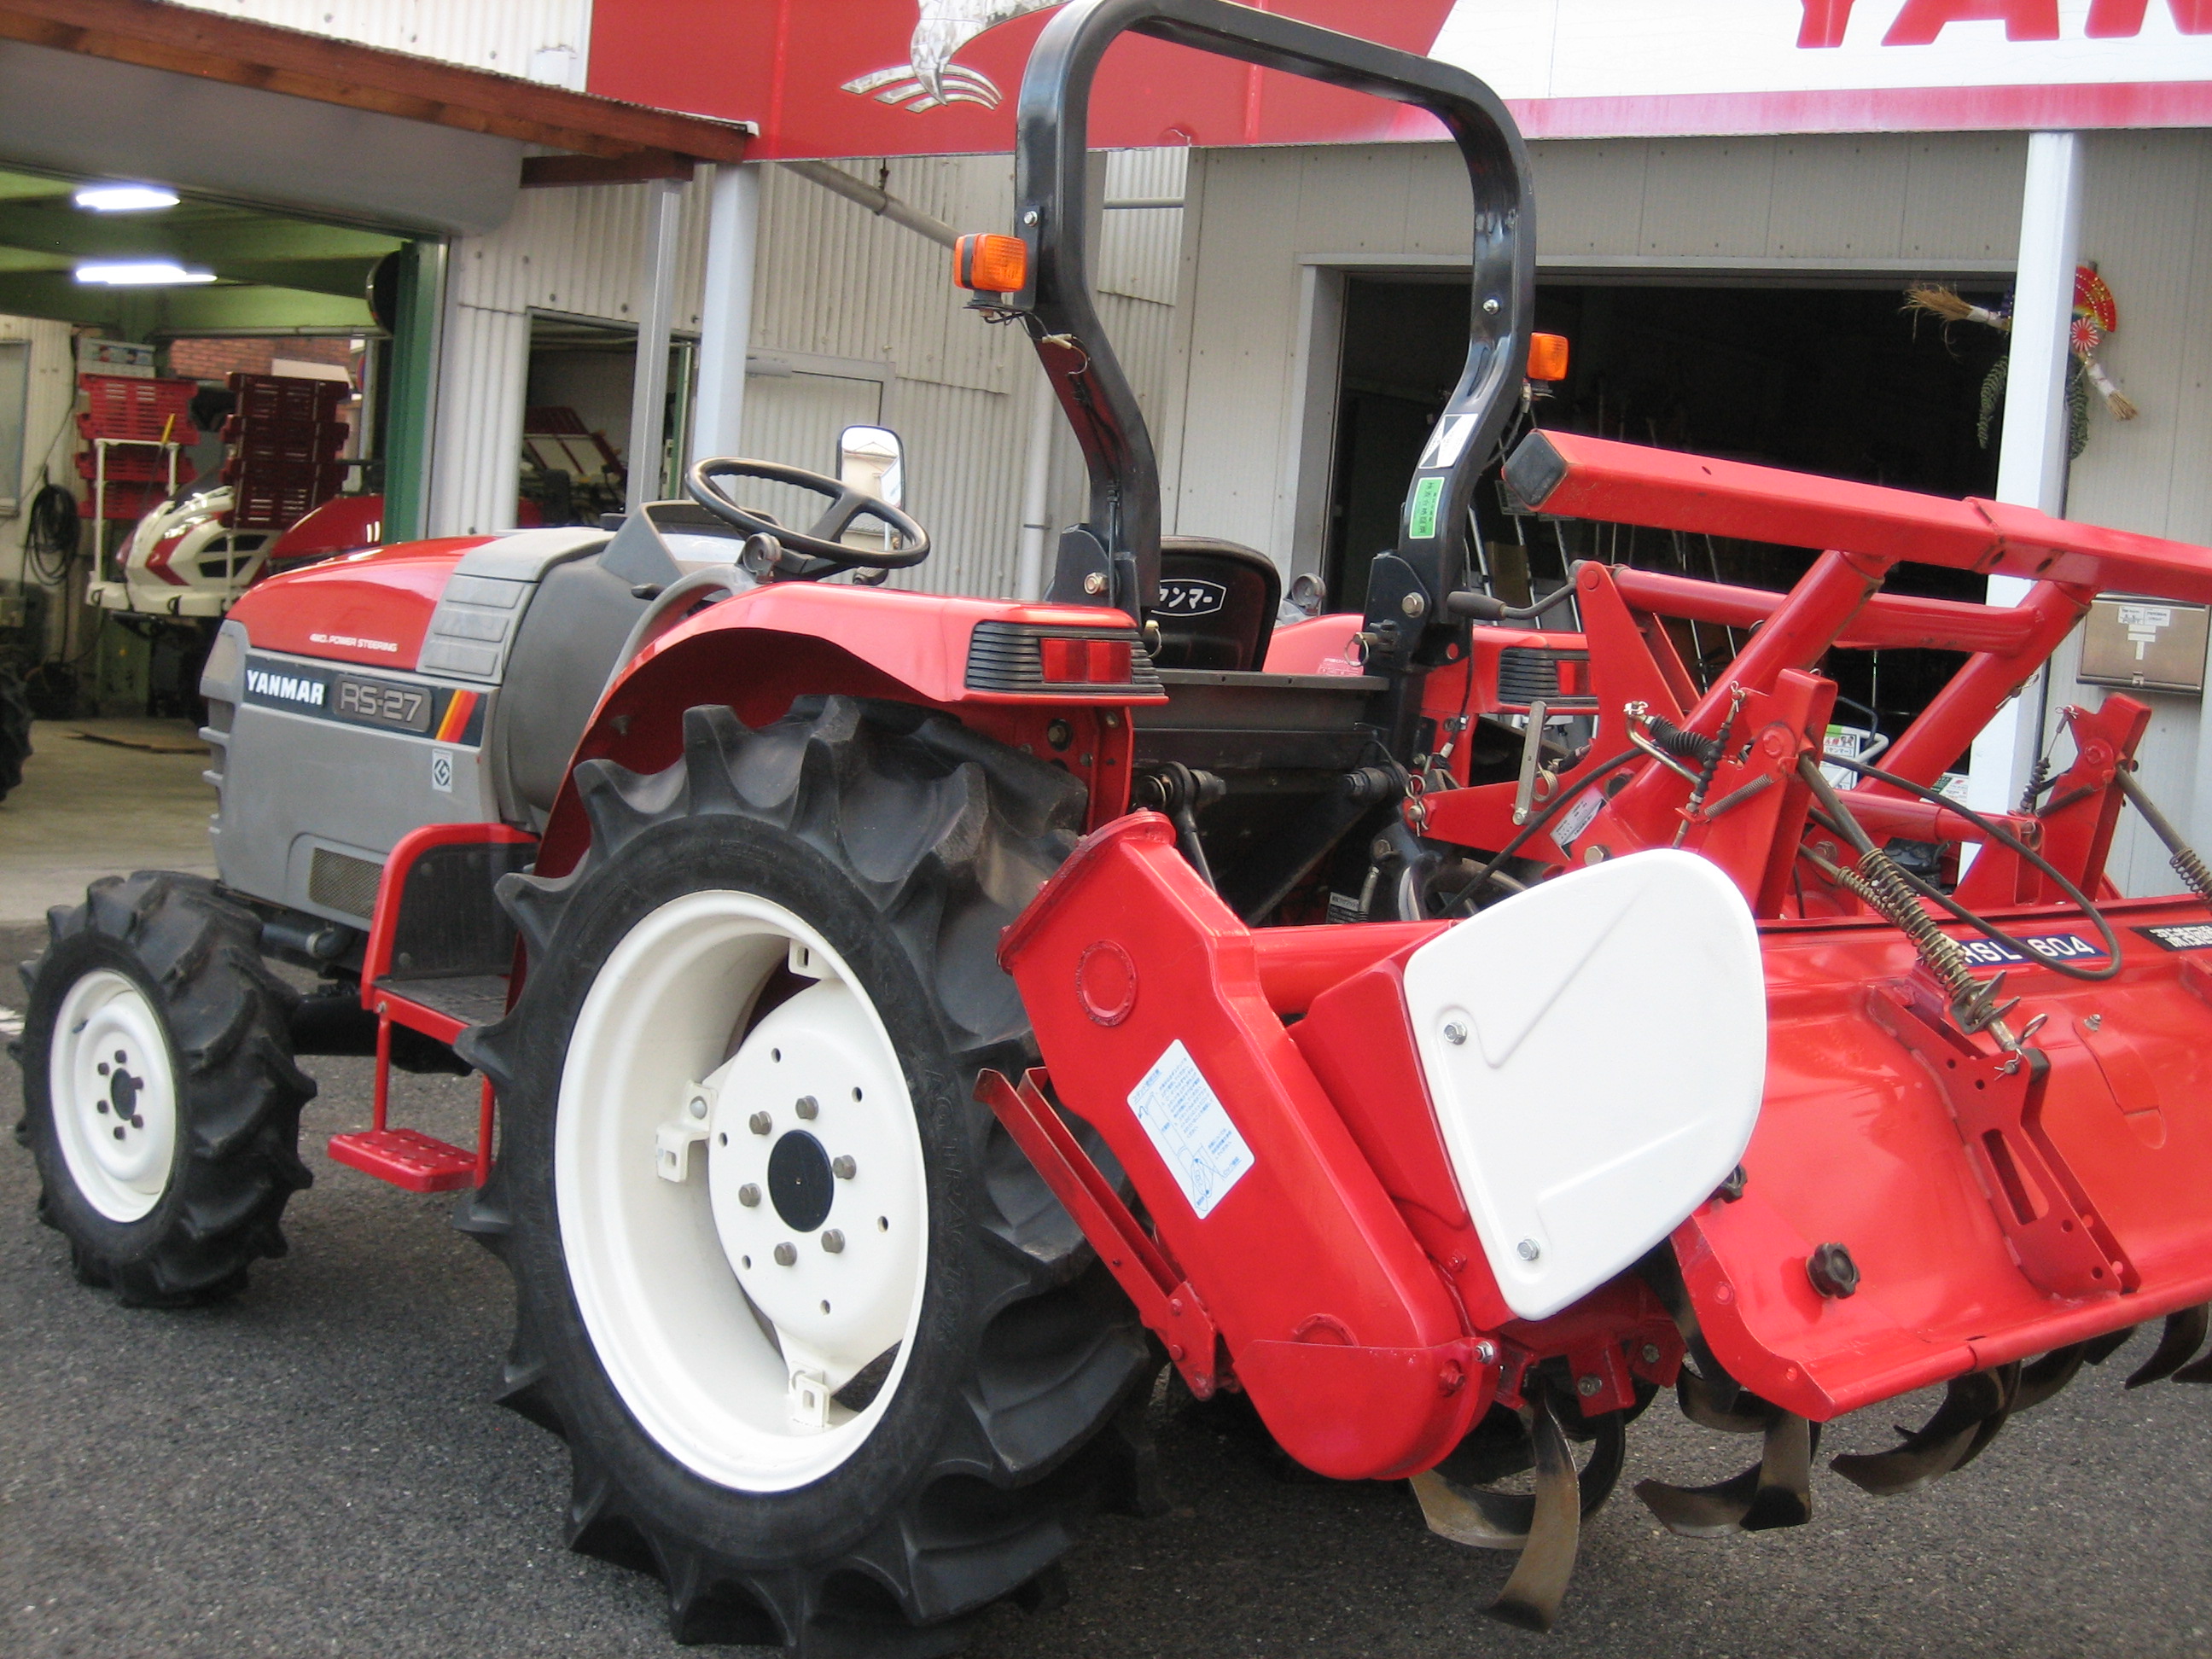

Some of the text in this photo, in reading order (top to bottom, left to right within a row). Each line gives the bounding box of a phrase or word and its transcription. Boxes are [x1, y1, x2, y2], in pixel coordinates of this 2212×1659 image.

[329, 635, 357, 646] POWER
[357, 638, 398, 653] STEERING
[247, 670, 423, 722] YANMAR RS-27
[2027, 936, 2096, 957] 604
